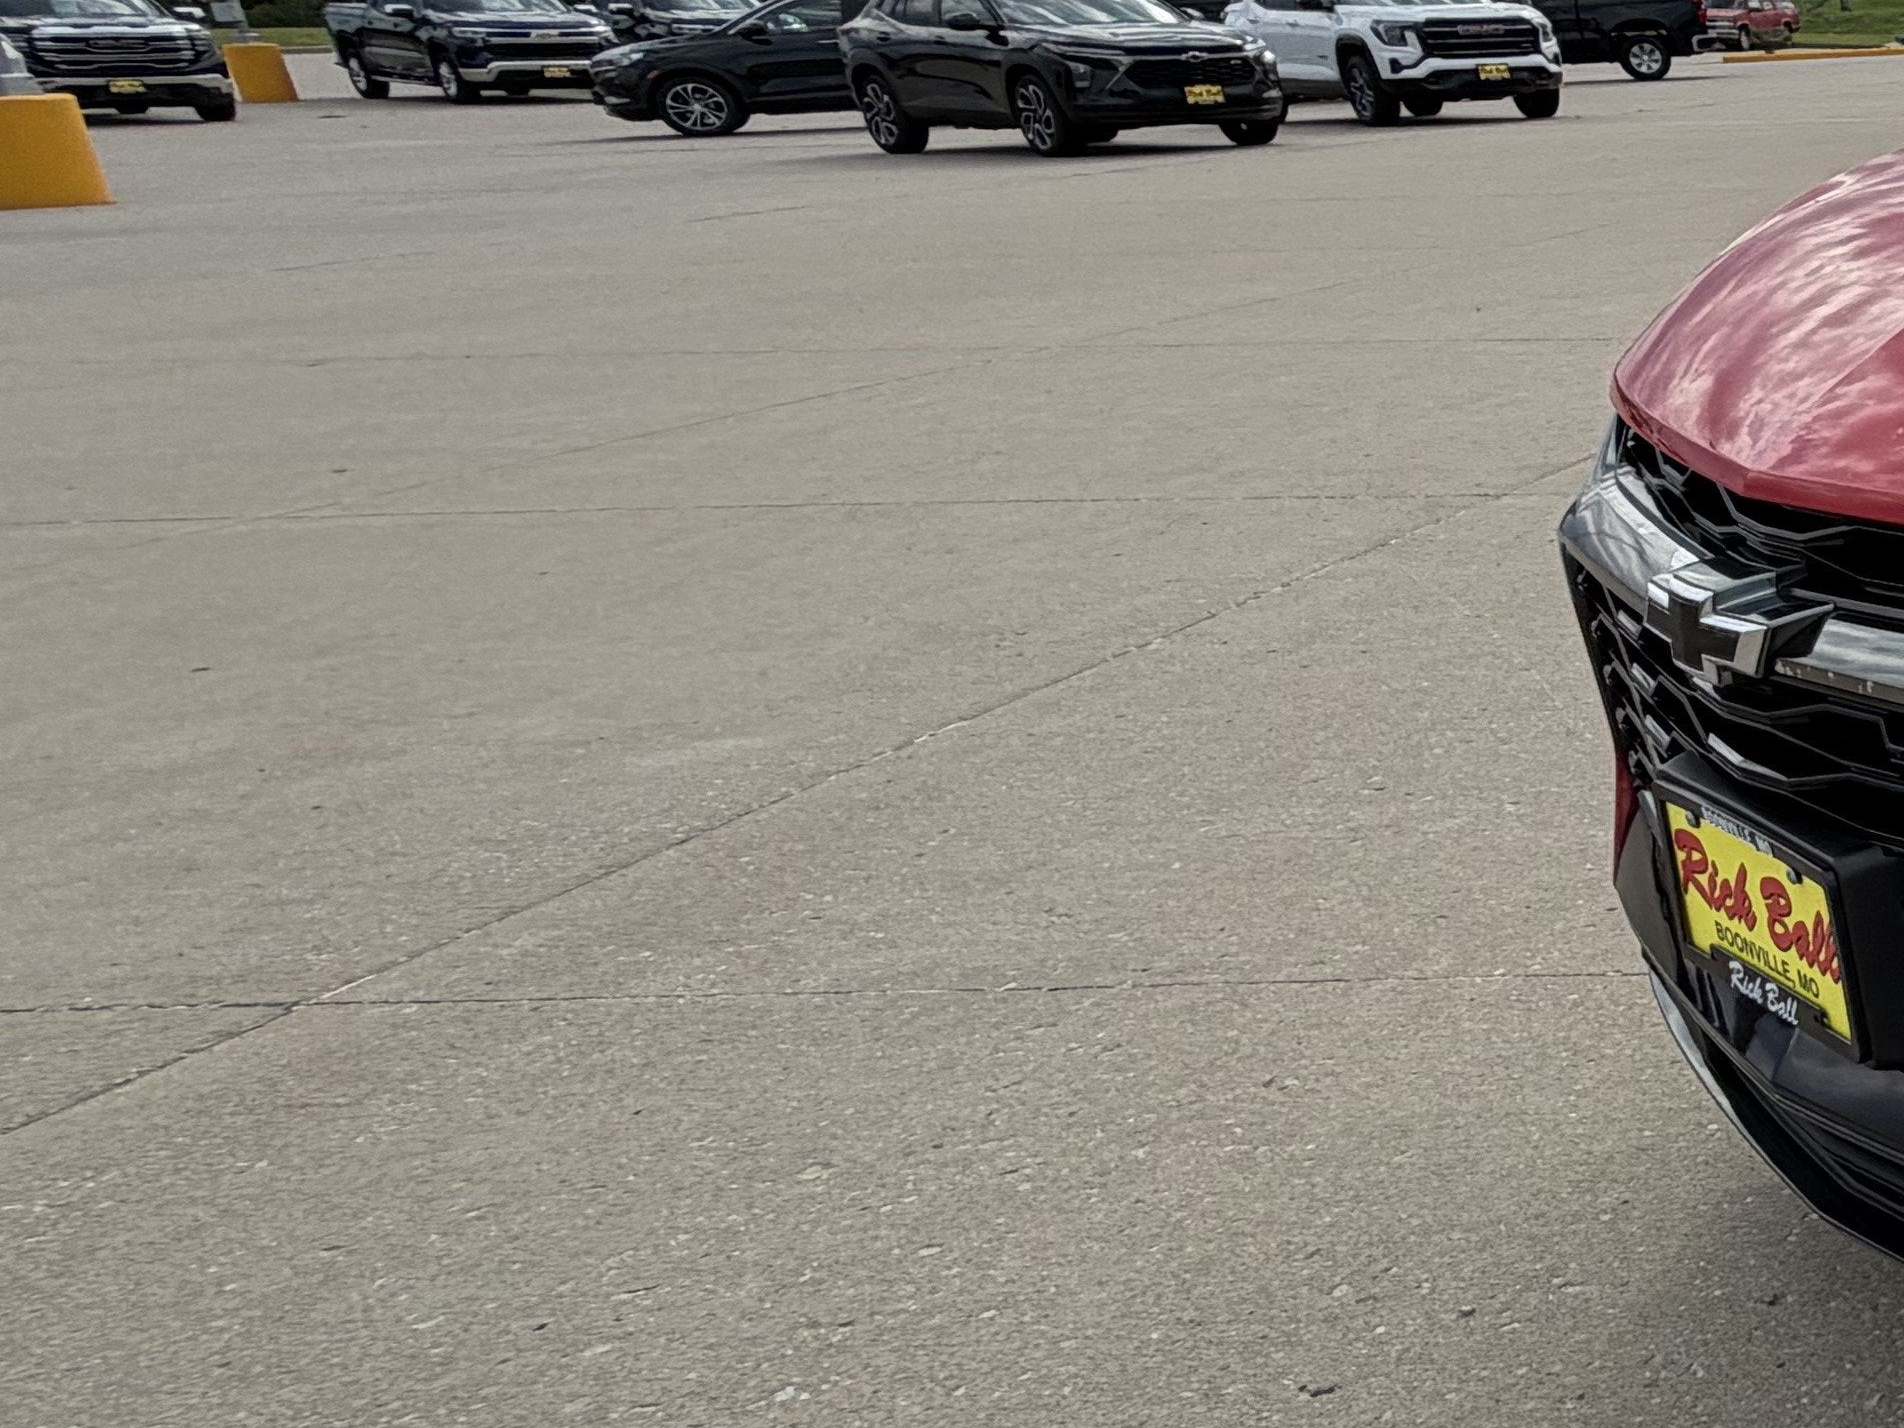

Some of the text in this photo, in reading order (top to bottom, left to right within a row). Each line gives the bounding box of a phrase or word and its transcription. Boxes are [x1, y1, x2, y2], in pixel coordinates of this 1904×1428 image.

[1674, 828, 1842, 985] Rick Ball
[1728, 960, 1798, 1026] Rick Ball
[1798, 969, 1820, 999] MO
